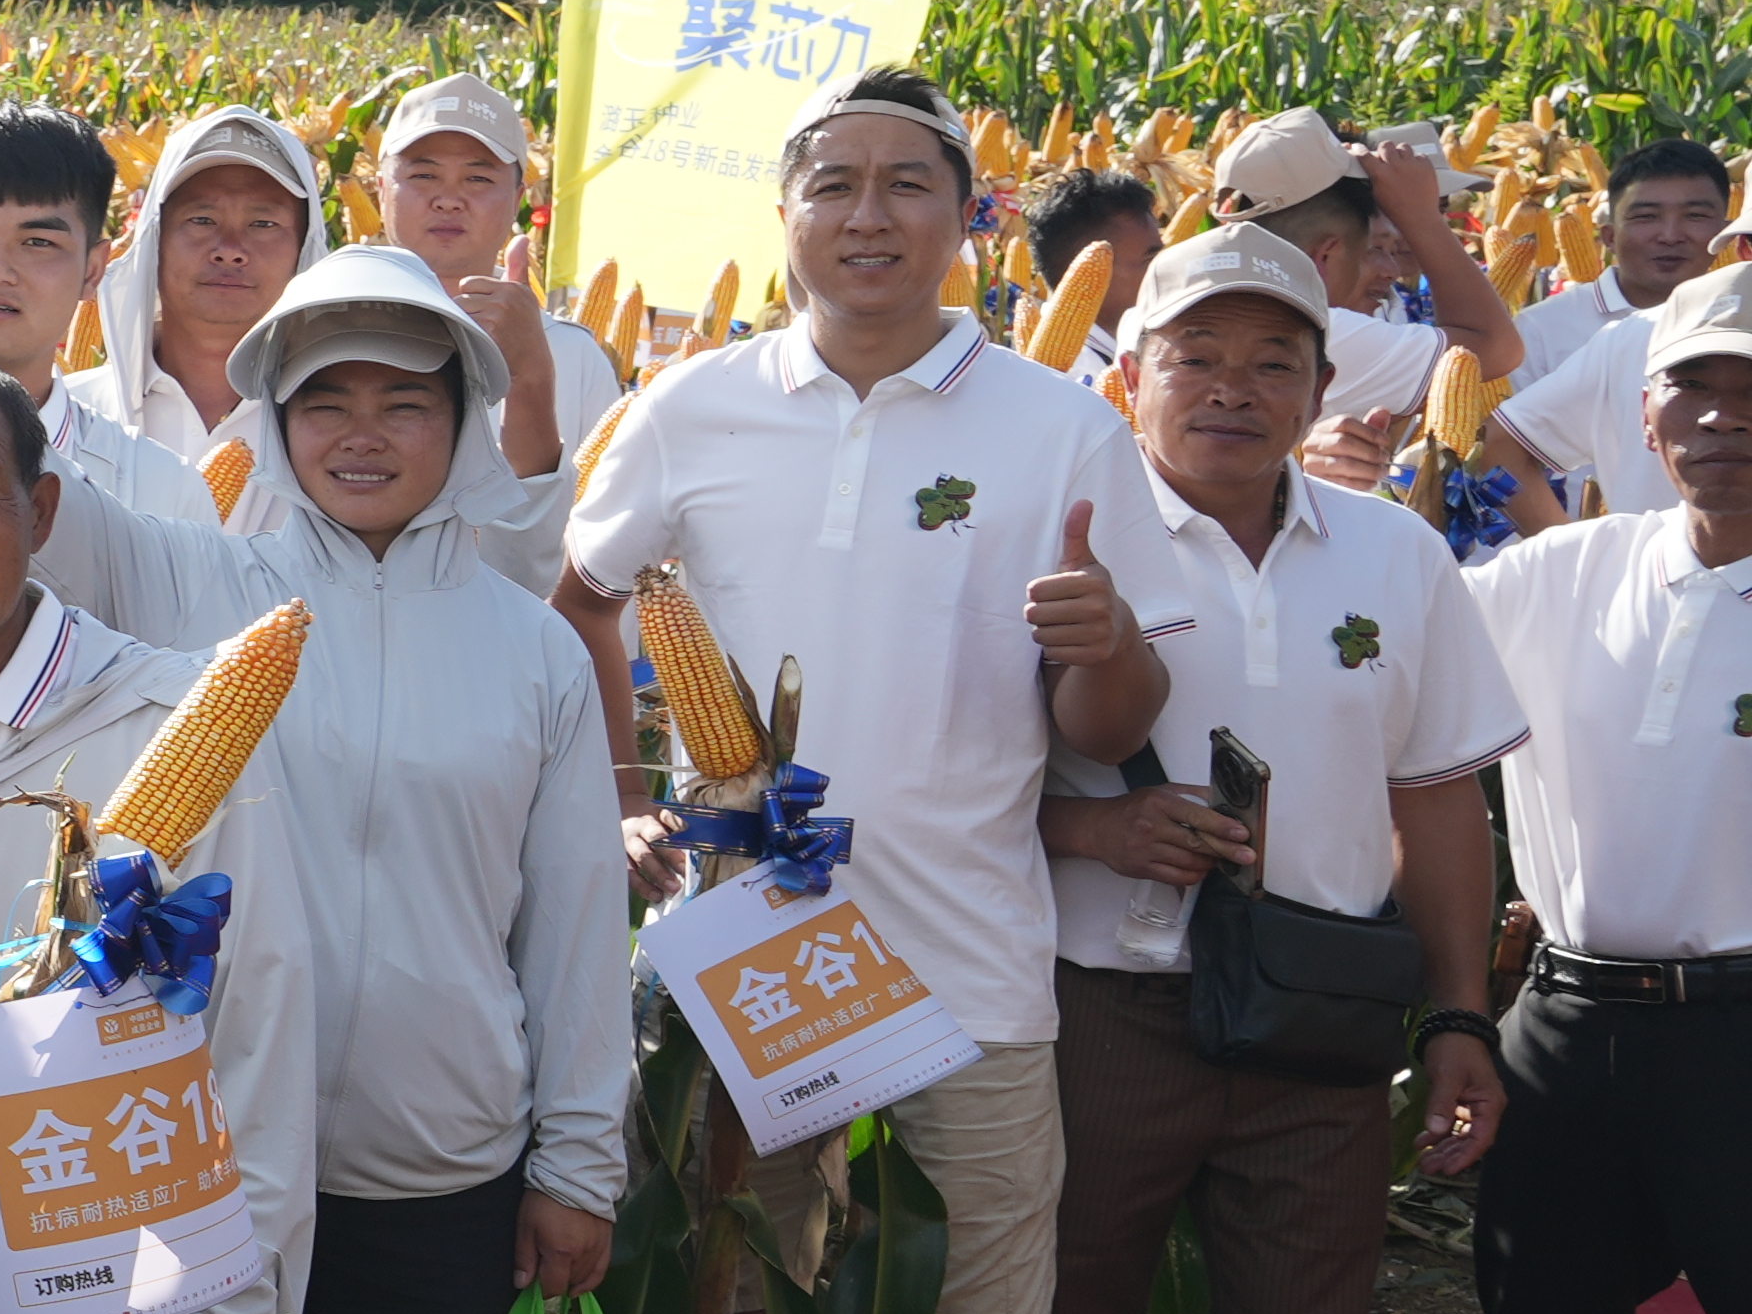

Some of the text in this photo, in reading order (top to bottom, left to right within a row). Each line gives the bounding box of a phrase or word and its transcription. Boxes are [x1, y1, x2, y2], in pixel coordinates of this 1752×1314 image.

[598, 101, 701, 133] 潞玉种业
[728, 920, 900, 1035] 金谷1
[761, 992, 882, 1062] 抗病耐热适应广
[780, 1070, 841, 1108] 订购热线
[8, 1067, 226, 1195] 金谷18
[29, 1176, 189, 1235] 抗病耐热适应广
[35, 1265, 115, 1297] 订购热线
